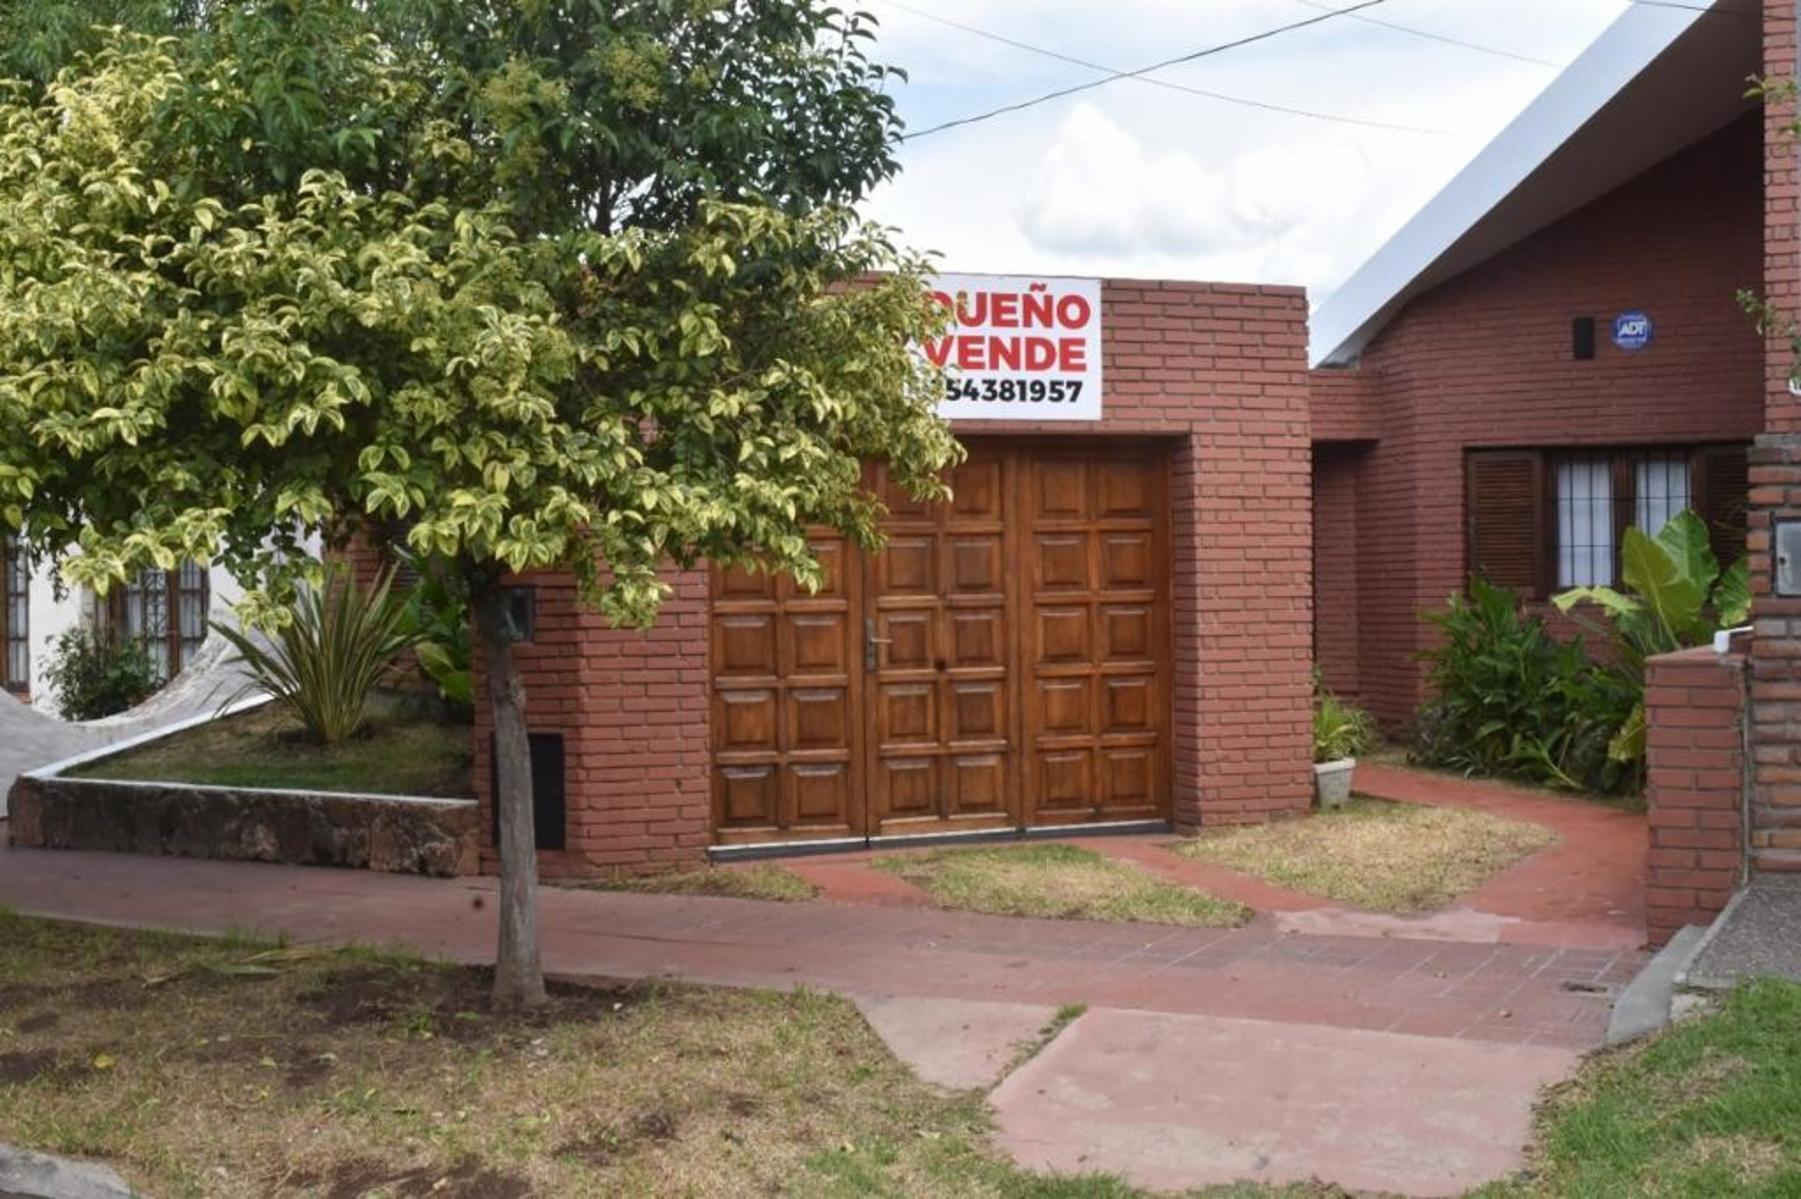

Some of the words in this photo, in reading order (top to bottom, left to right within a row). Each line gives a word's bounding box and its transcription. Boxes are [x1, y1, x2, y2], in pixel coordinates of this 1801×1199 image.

[1618, 321, 1645, 337] ADT
[922, 334, 1087, 372] VENDE
[931, 378, 1083, 403] 54381957
